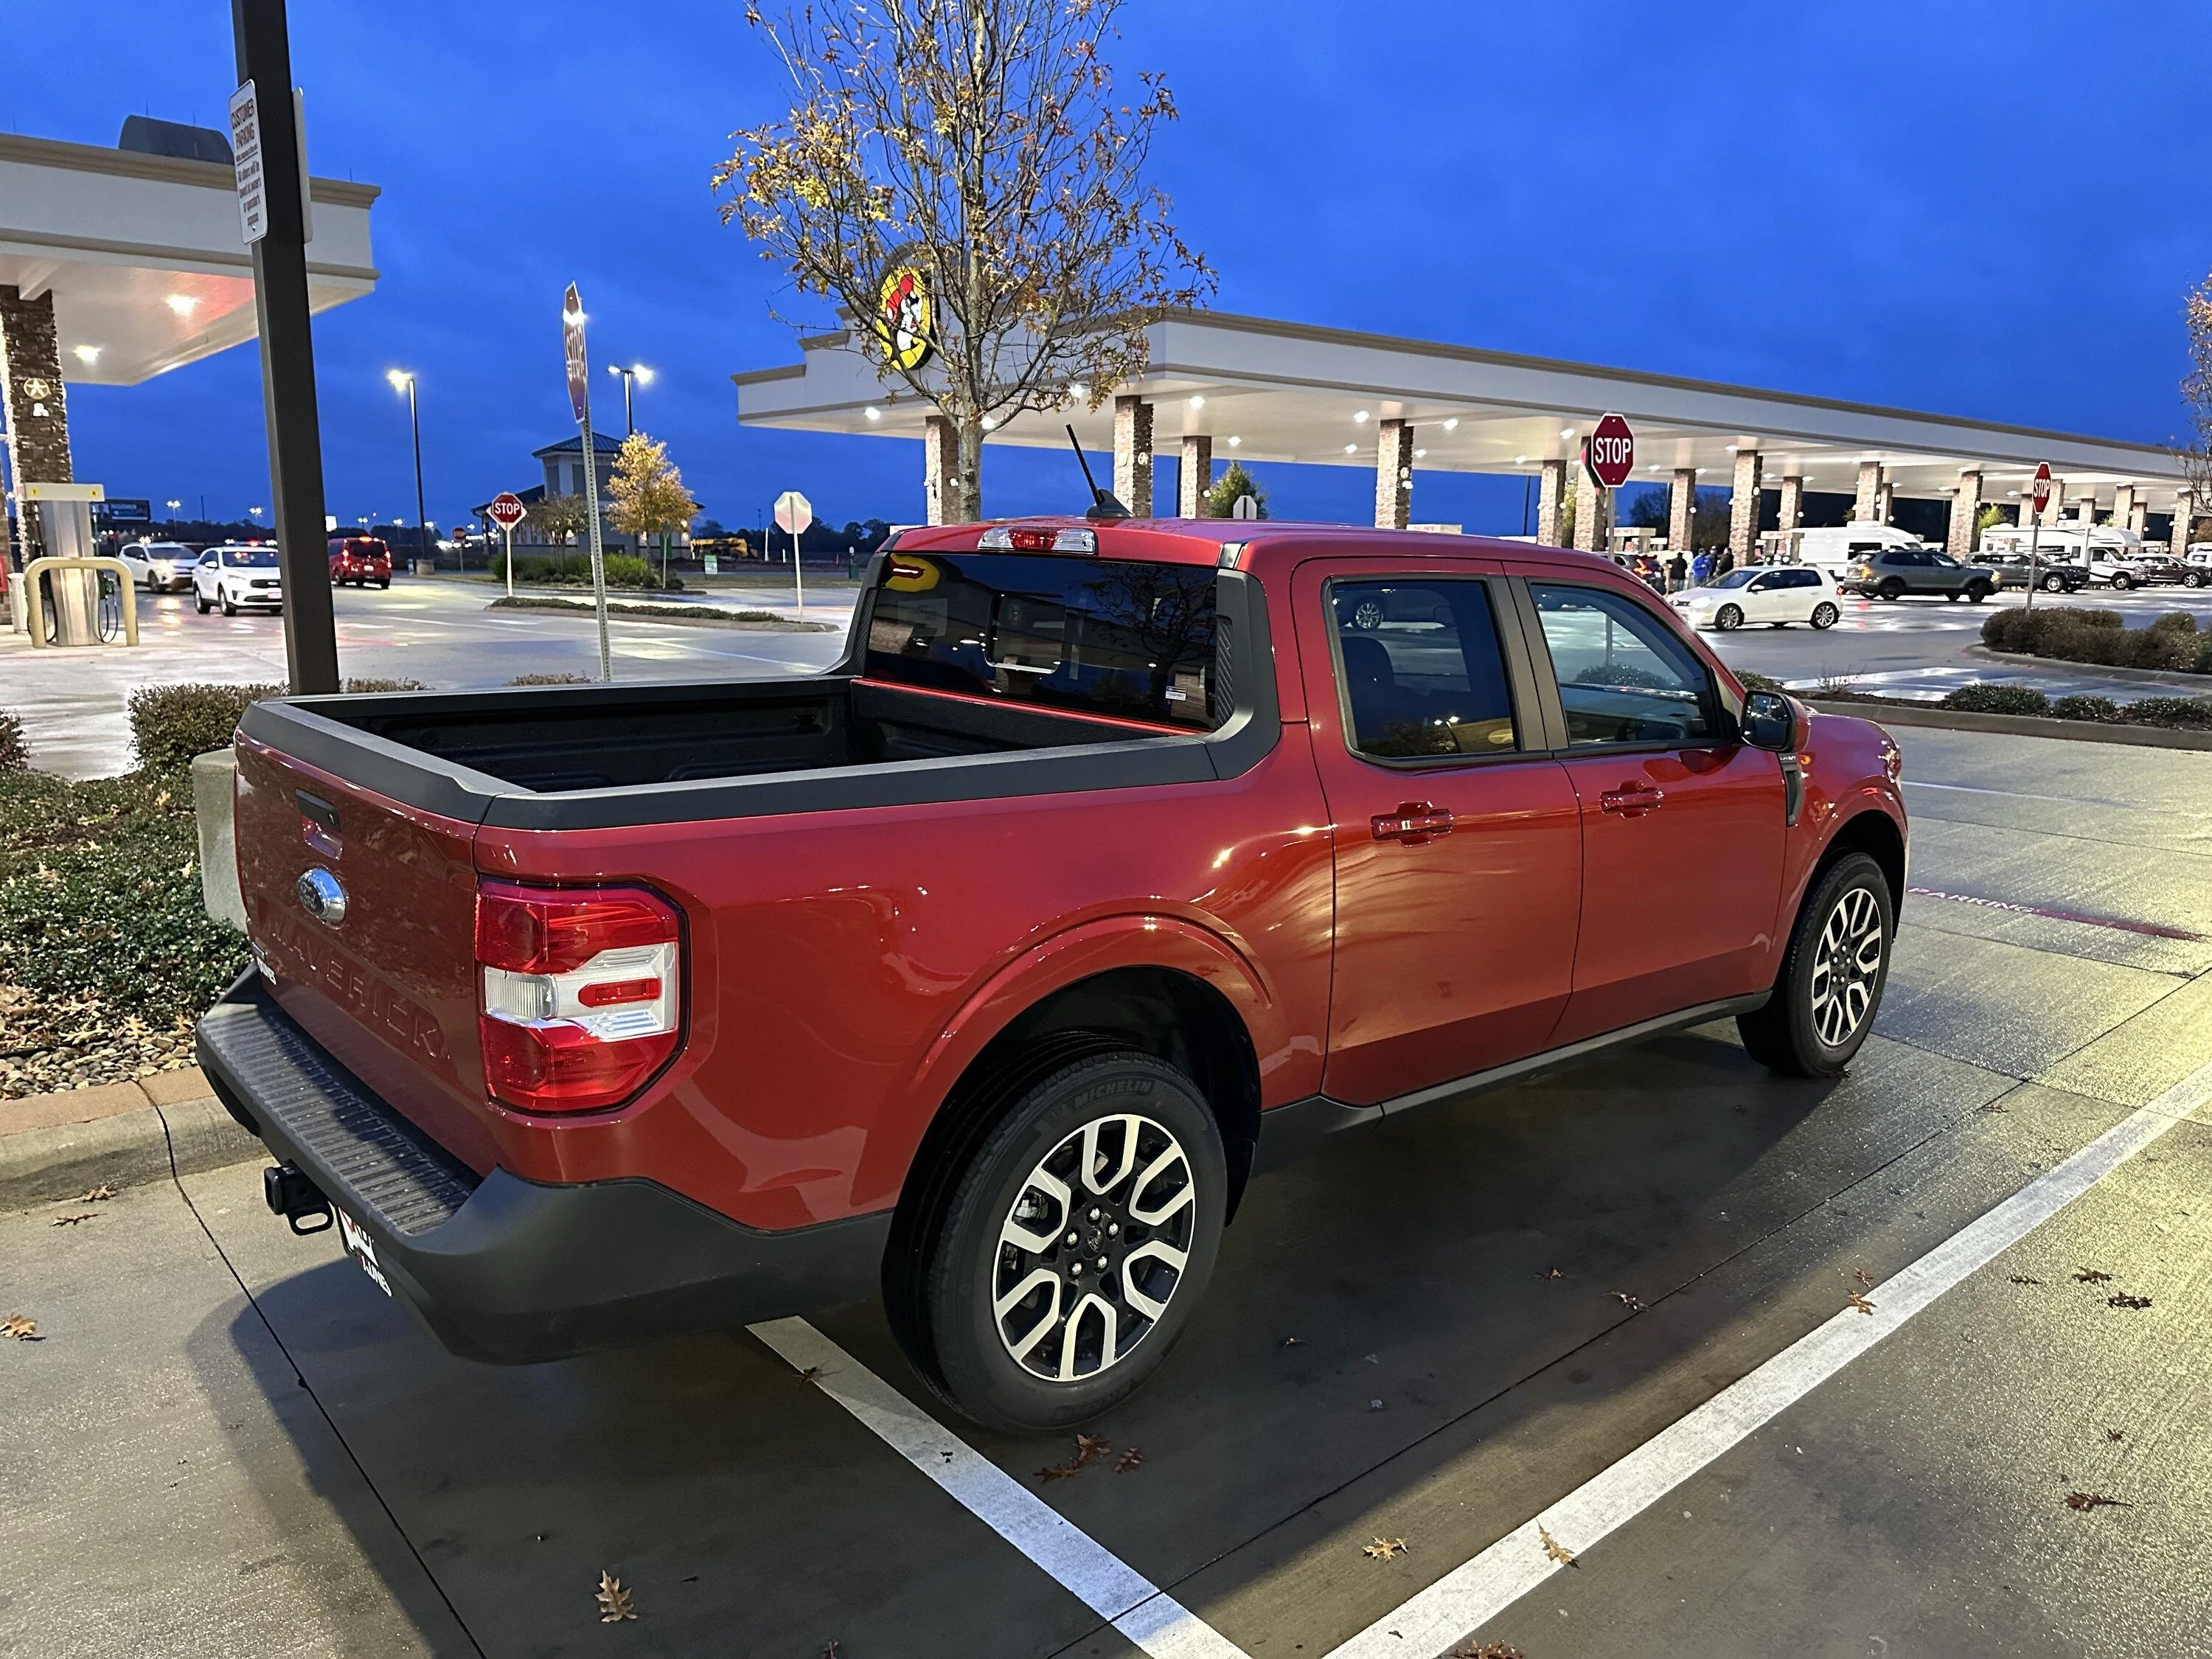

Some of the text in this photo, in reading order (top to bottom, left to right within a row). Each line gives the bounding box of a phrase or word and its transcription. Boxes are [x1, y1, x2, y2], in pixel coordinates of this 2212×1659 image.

[231, 98, 254, 130] CUSTOMER
[235, 122, 254, 150] PARKING
[566, 324, 585, 383] STOP
[1595, 437, 1632, 465] STOP
[2034, 478, 2050, 498] STOP
[495, 502, 521, 515] STOP
[1907, 887, 2035, 913] PARKING
[1075, 1080, 1152, 1108] MICHELIN
